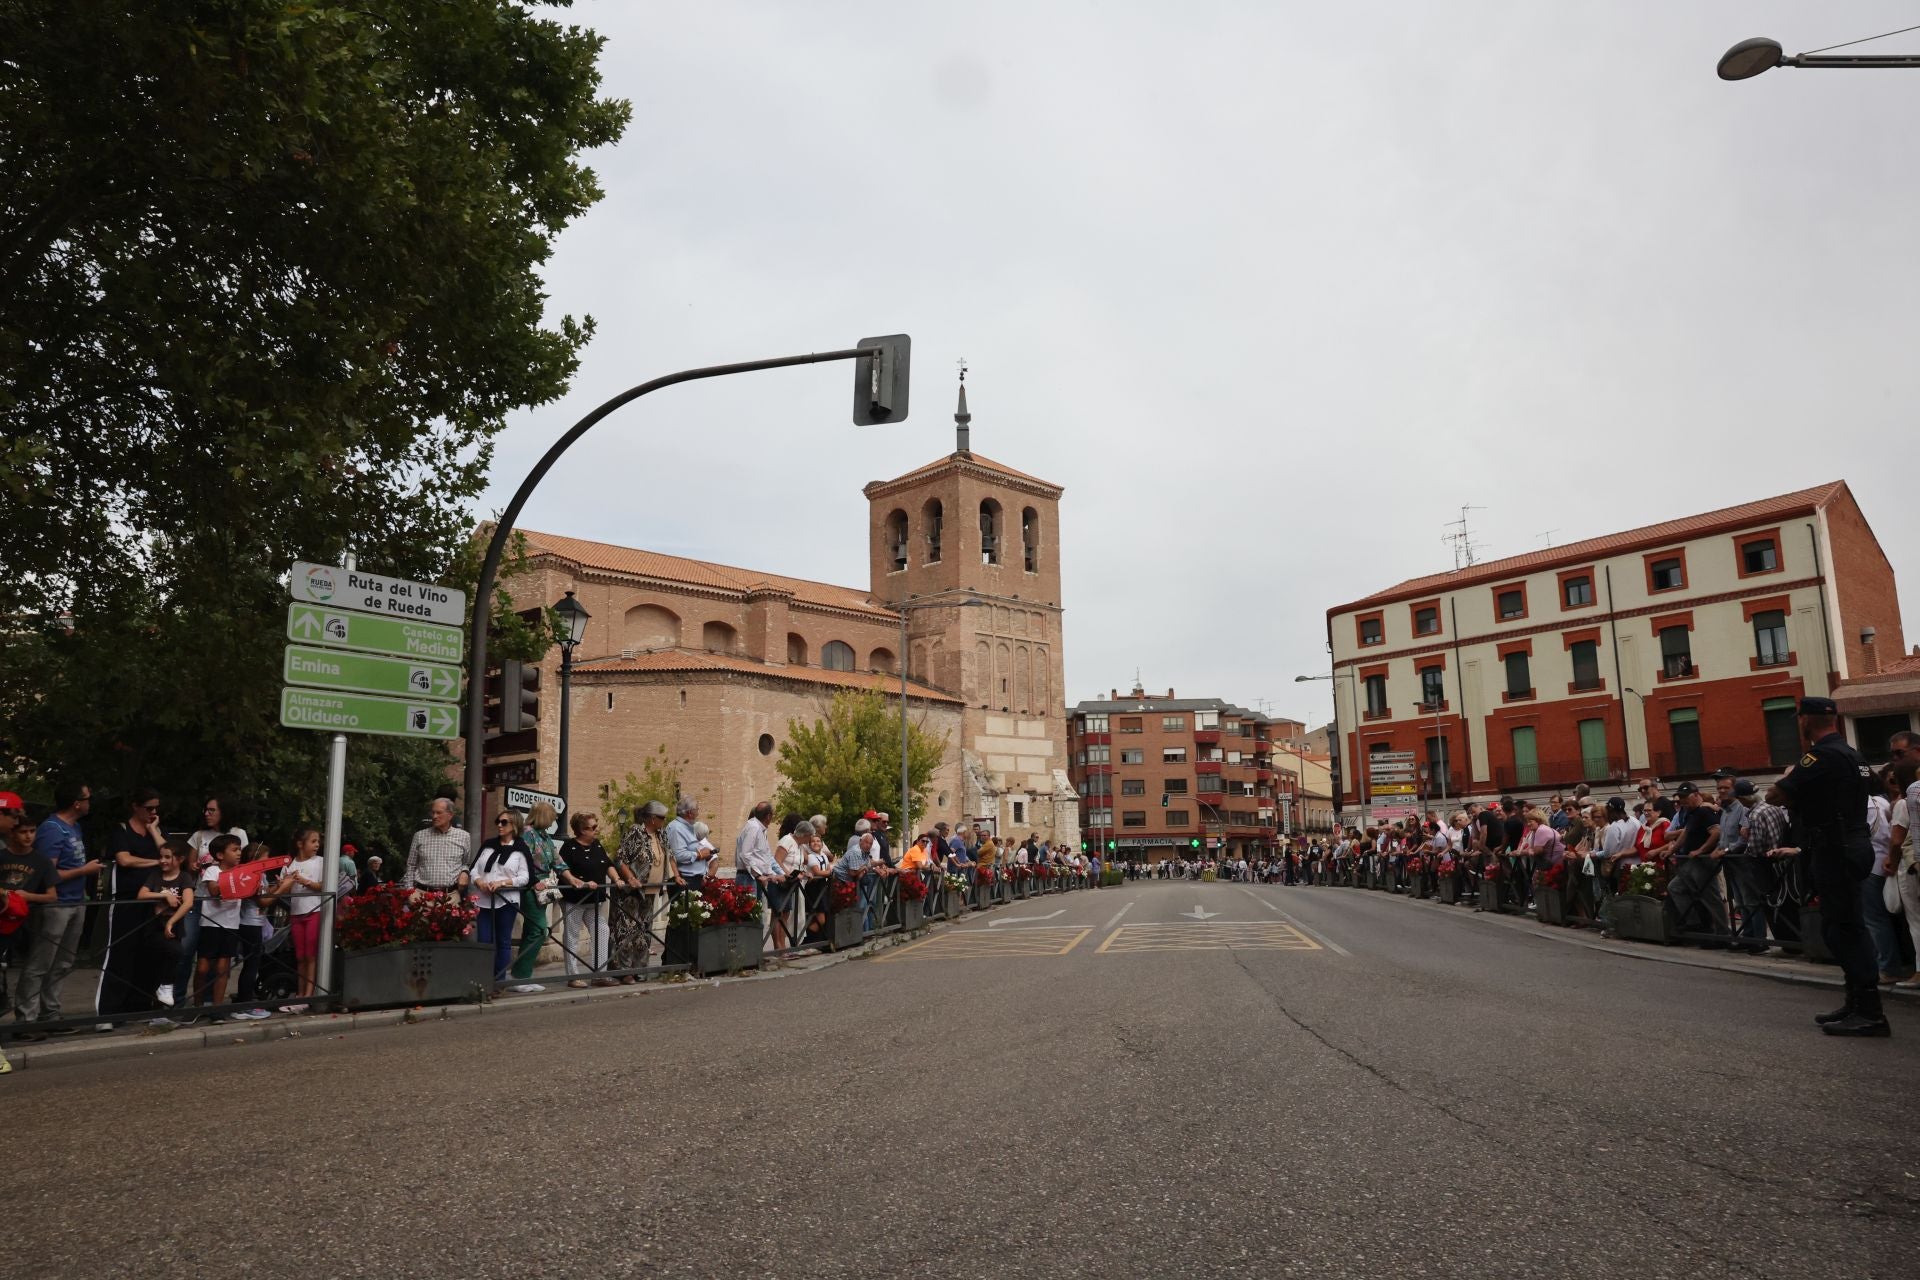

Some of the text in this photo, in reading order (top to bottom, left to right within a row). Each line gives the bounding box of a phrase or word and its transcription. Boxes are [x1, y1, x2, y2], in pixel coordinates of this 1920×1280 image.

[310, 578, 332, 588] RUEDA
[348, 575, 448, 604] Ruta del Vino
[364, 596, 432, 617] de Rueda
[402, 626, 458, 642] Castelo de
[406, 638, 457, 658] Medina
[291, 656, 341, 676] Emina
[289, 694, 344, 709] Almazara
[287, 706, 359, 726] Oliduero
